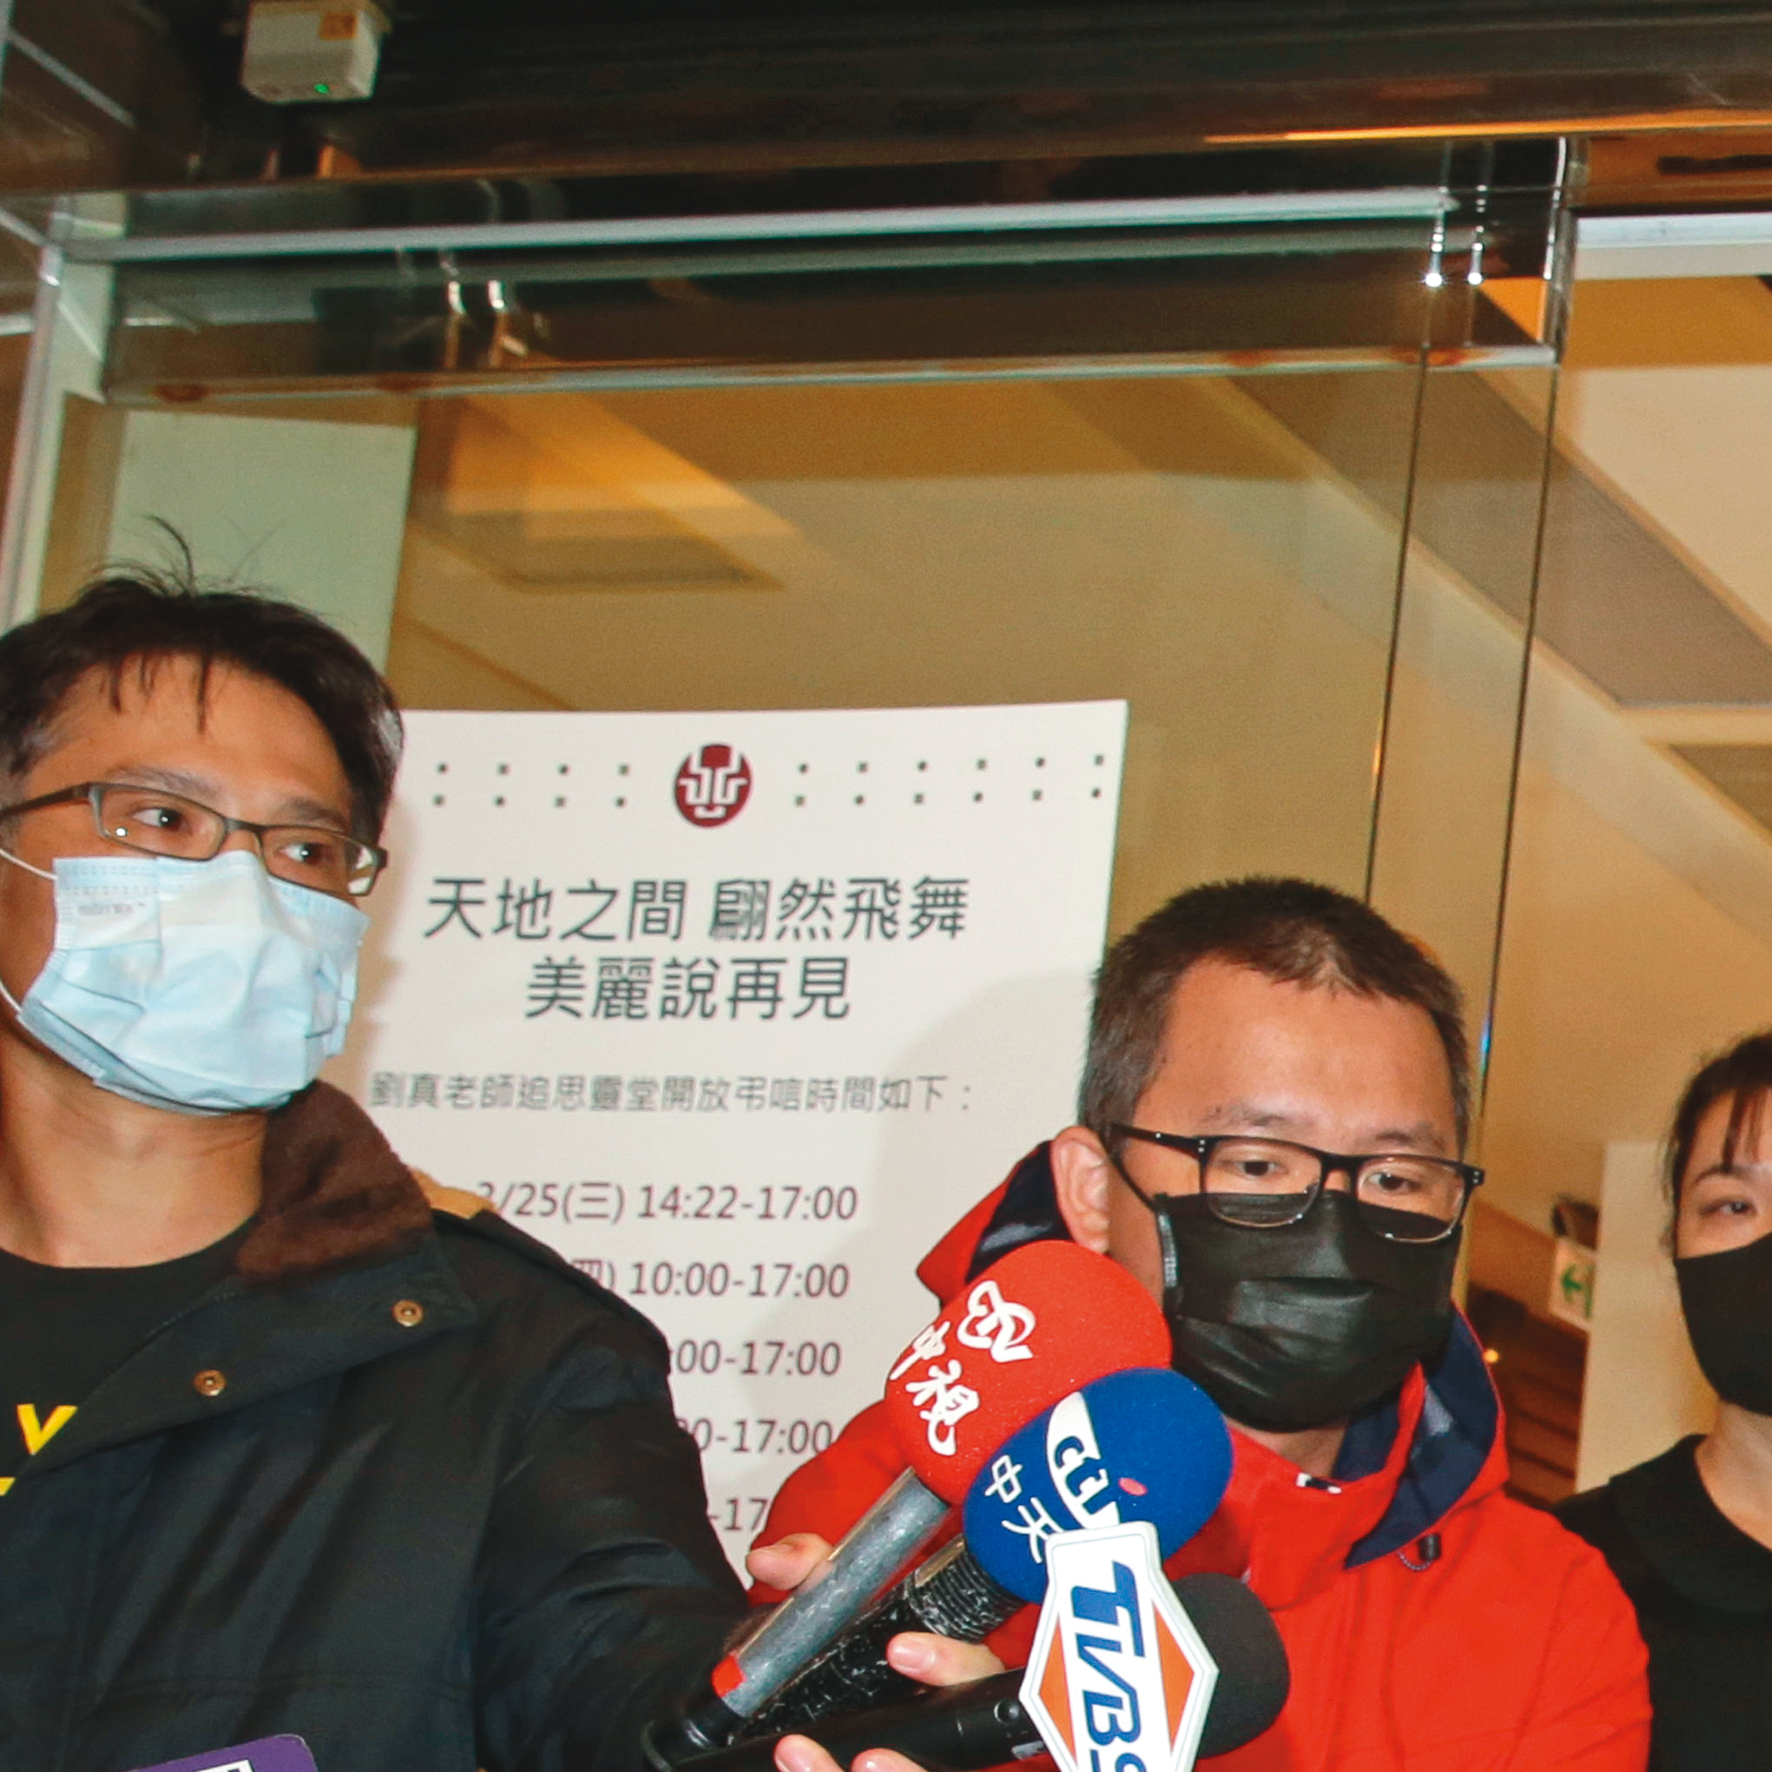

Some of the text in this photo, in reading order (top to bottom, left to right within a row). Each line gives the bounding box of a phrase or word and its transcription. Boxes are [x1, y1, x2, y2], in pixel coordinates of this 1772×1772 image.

[424, 876, 971, 943] 天地之間 翩然飛舞
[525, 955, 851, 1020] 美麗說再見
[637, 1185, 859, 1221] 14:22-17:00
[630, 1262, 851, 1298] 10:00-17:00
[676, 1339, 842, 1376] 00-17:00
[889, 1320, 981, 1457] 中視
[983, 1454, 1066, 1565] 中天
